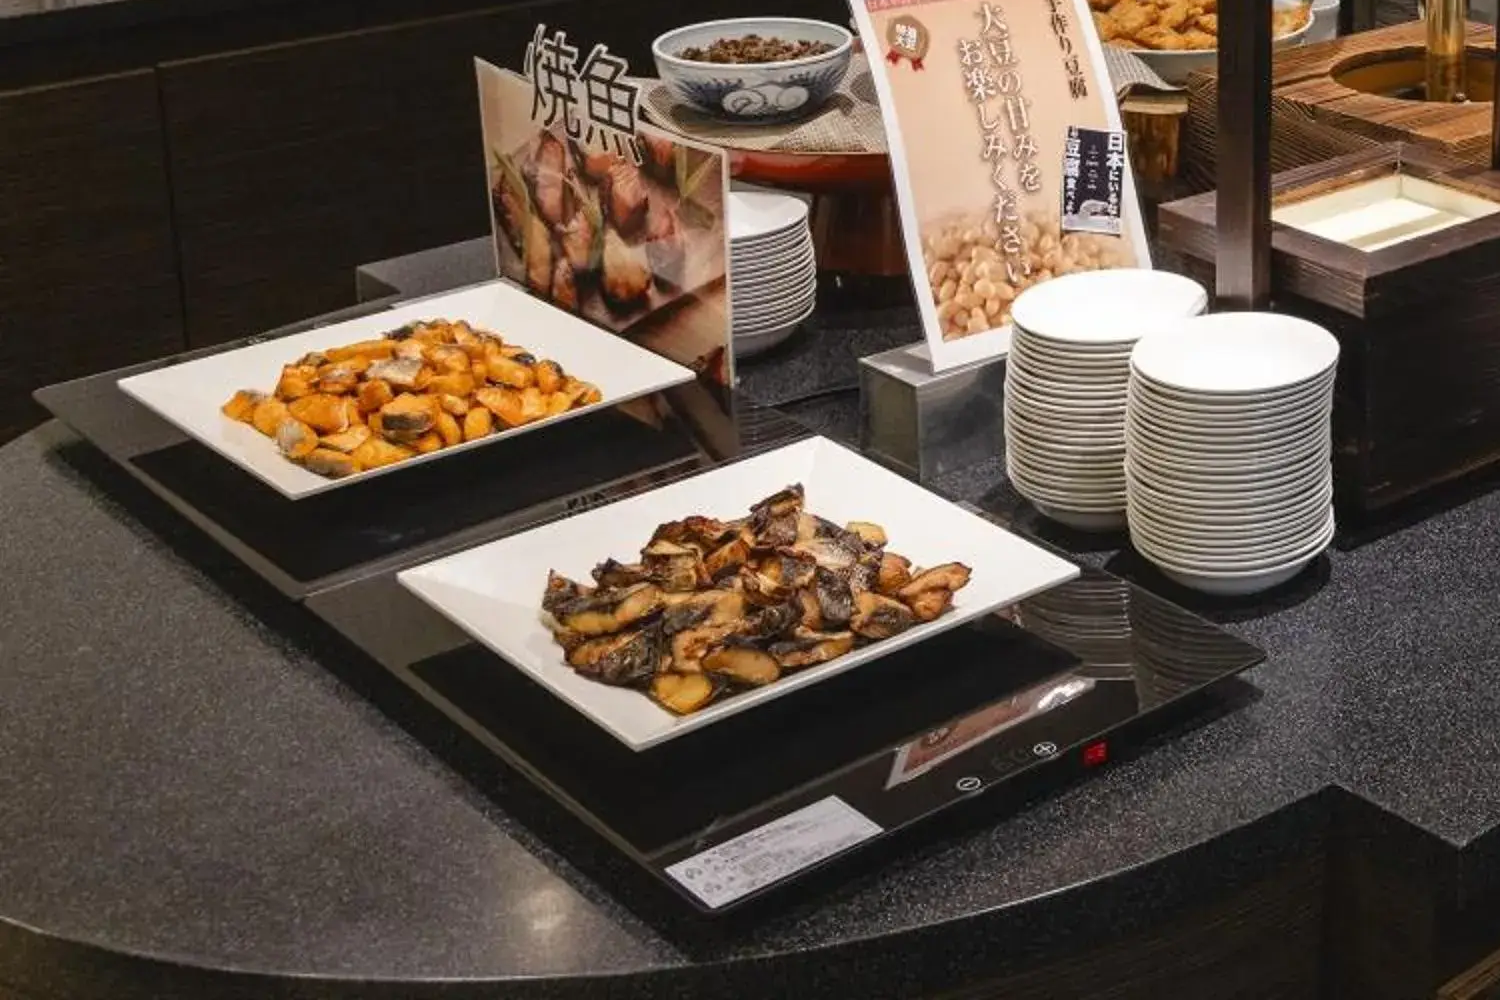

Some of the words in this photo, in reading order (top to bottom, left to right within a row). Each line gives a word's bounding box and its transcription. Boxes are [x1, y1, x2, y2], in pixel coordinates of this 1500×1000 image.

[524, 24, 643, 166] 焼魚
[958, 38, 1032, 284] お楽しみください
